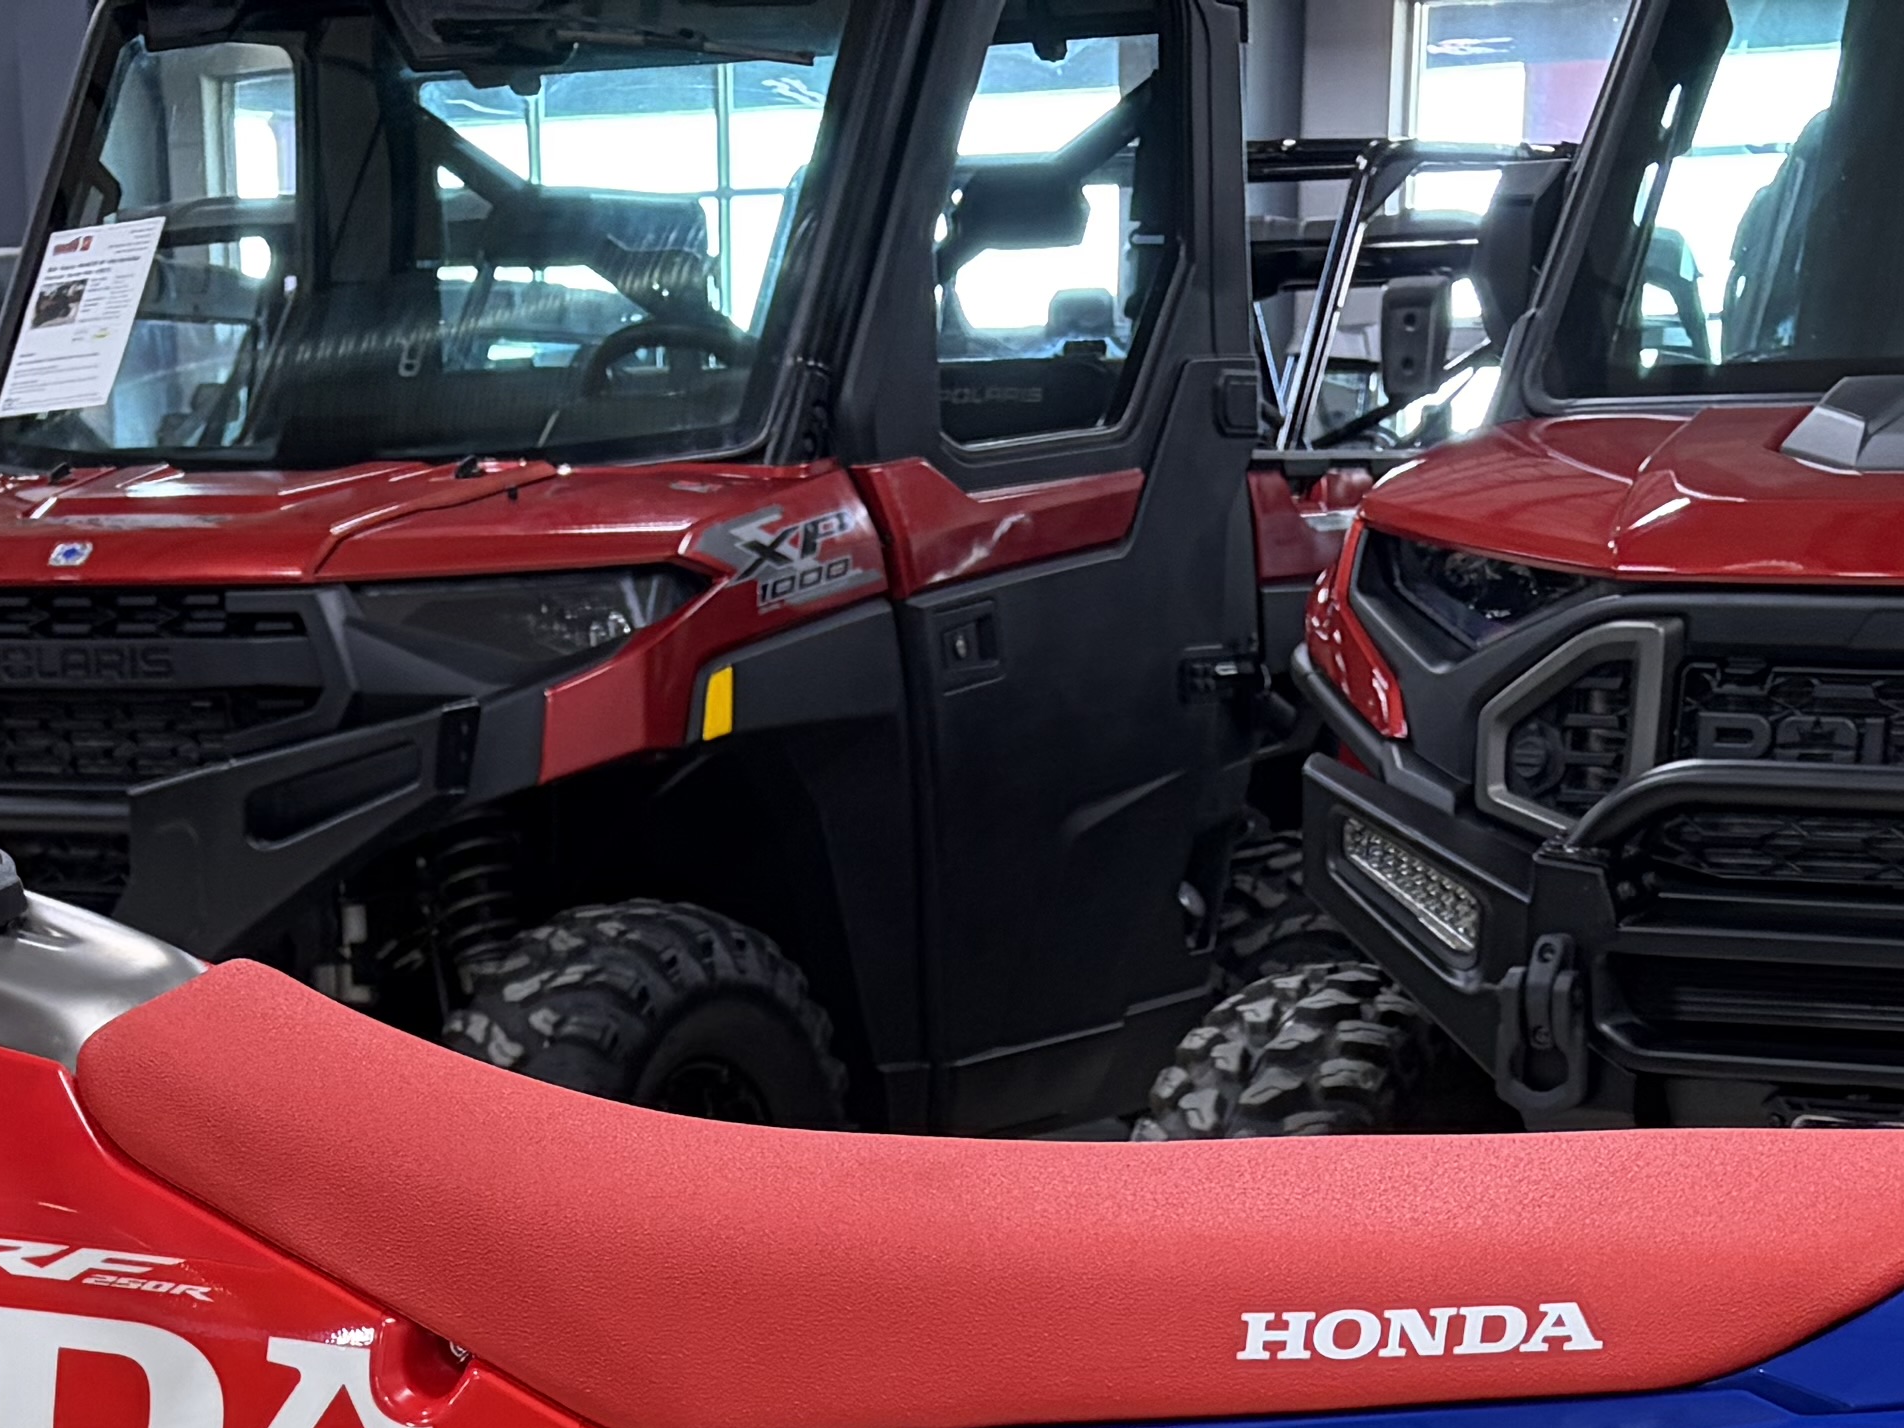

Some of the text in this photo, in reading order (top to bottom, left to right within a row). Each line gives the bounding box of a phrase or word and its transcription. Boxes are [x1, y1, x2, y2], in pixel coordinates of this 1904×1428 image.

[732, 510, 852, 583] XP
[760, 558, 850, 602] 1000
[82, 1273, 214, 1302] 250R
[1236, 1301, 1604, 1360] HONDA
